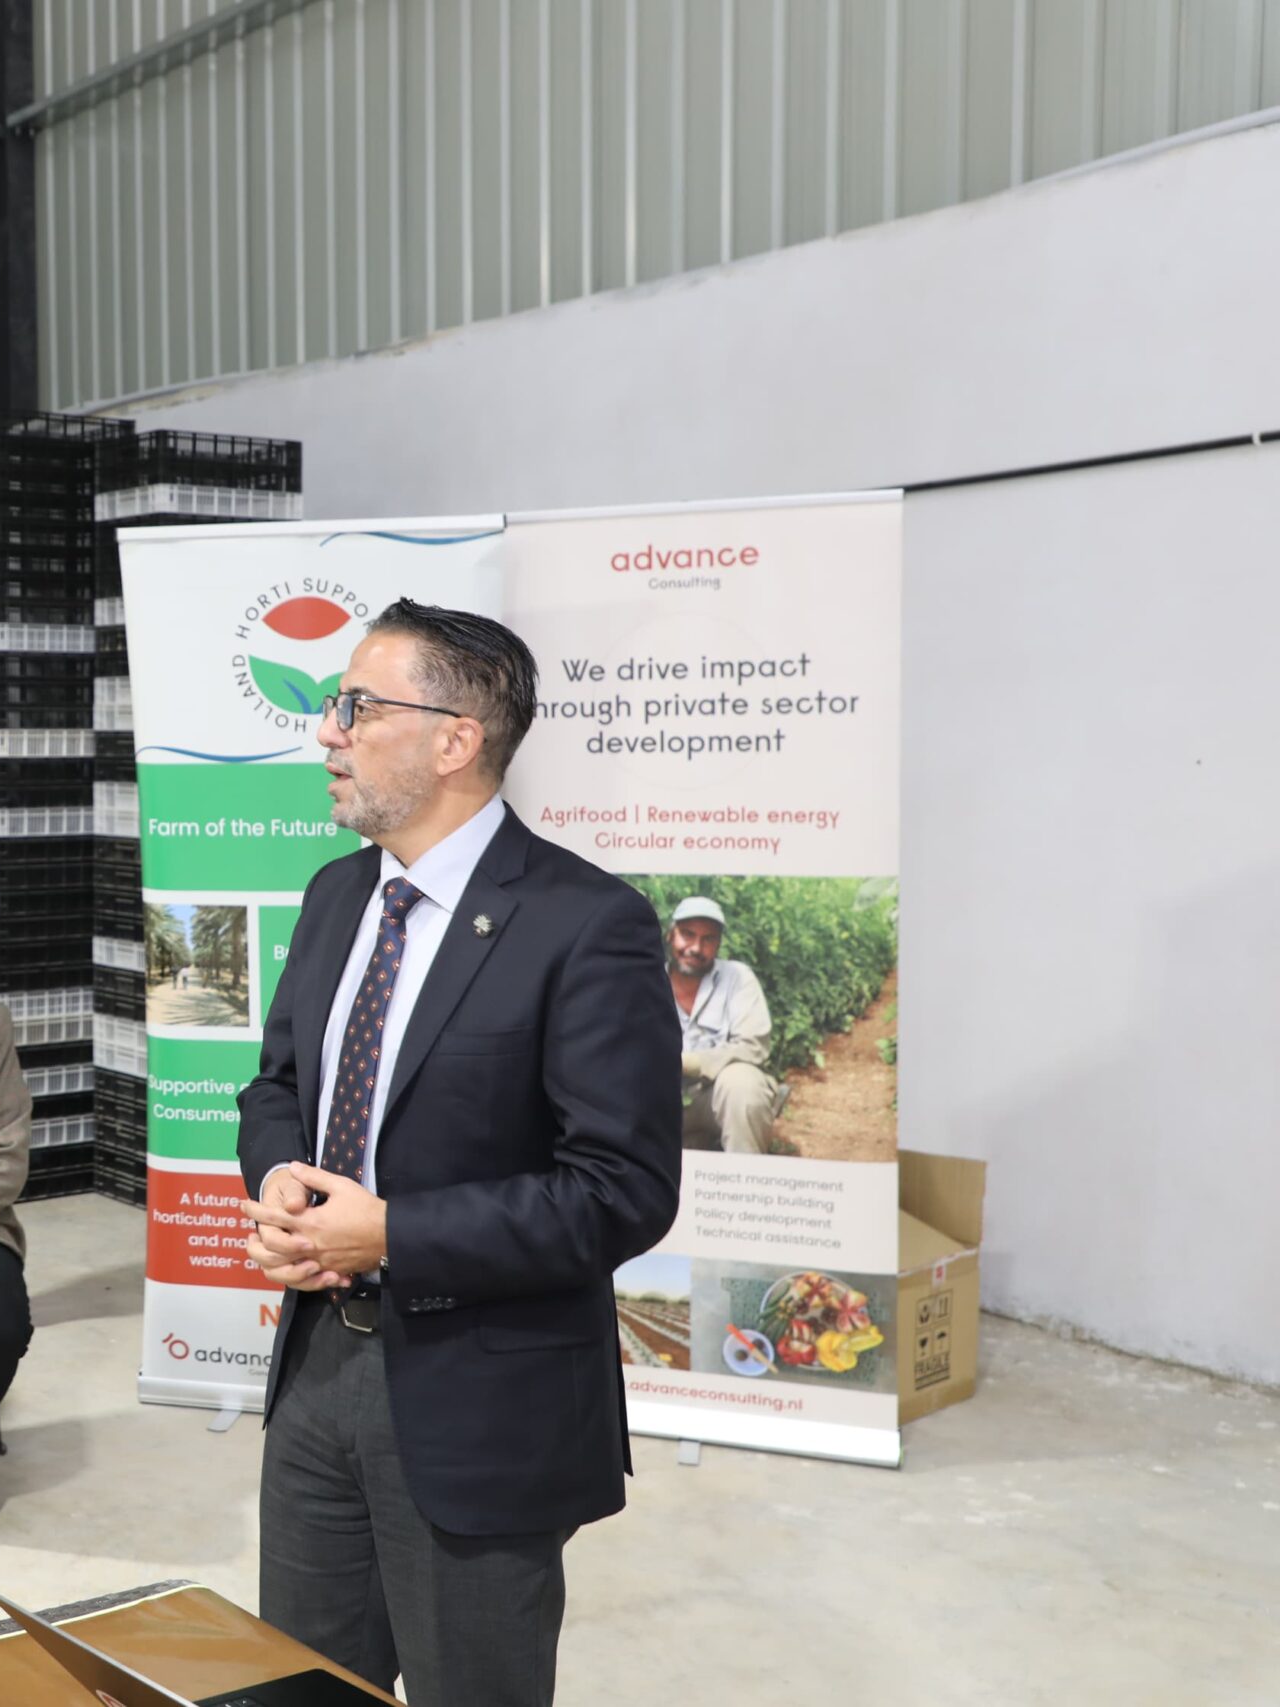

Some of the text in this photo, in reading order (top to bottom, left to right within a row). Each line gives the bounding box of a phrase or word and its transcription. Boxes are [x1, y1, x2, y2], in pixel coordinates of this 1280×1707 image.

[610, 544, 760, 572] advance
[648, 576, 722, 591] Consulting
[234, 581, 291, 639] HORTI
[561, 652, 811, 685] We drive impact
[231, 654, 307, 733] HOLLAND
[532, 690, 860, 725] hrough private sector
[586, 728, 786, 760] development
[148, 817, 338, 837] Farm of the Future
[540, 805, 627, 828] Agrifood
[647, 805, 759, 824] Renewable
[767, 808, 841, 829] energy
[594, 831, 781, 854] Circular economy
[148, 1074, 236, 1097] Supportive
[694, 1169, 844, 1192] Project management
[179, 1192, 191, 1205] A
[694, 1188, 835, 1213] Partnership building
[153, 1208, 238, 1228] horticulture
[694, 1207, 832, 1229] Policy development
[188, 1234, 219, 1247] and
[695, 1225, 841, 1249] Technical assistance
[189, 1255, 241, 1268] water-
